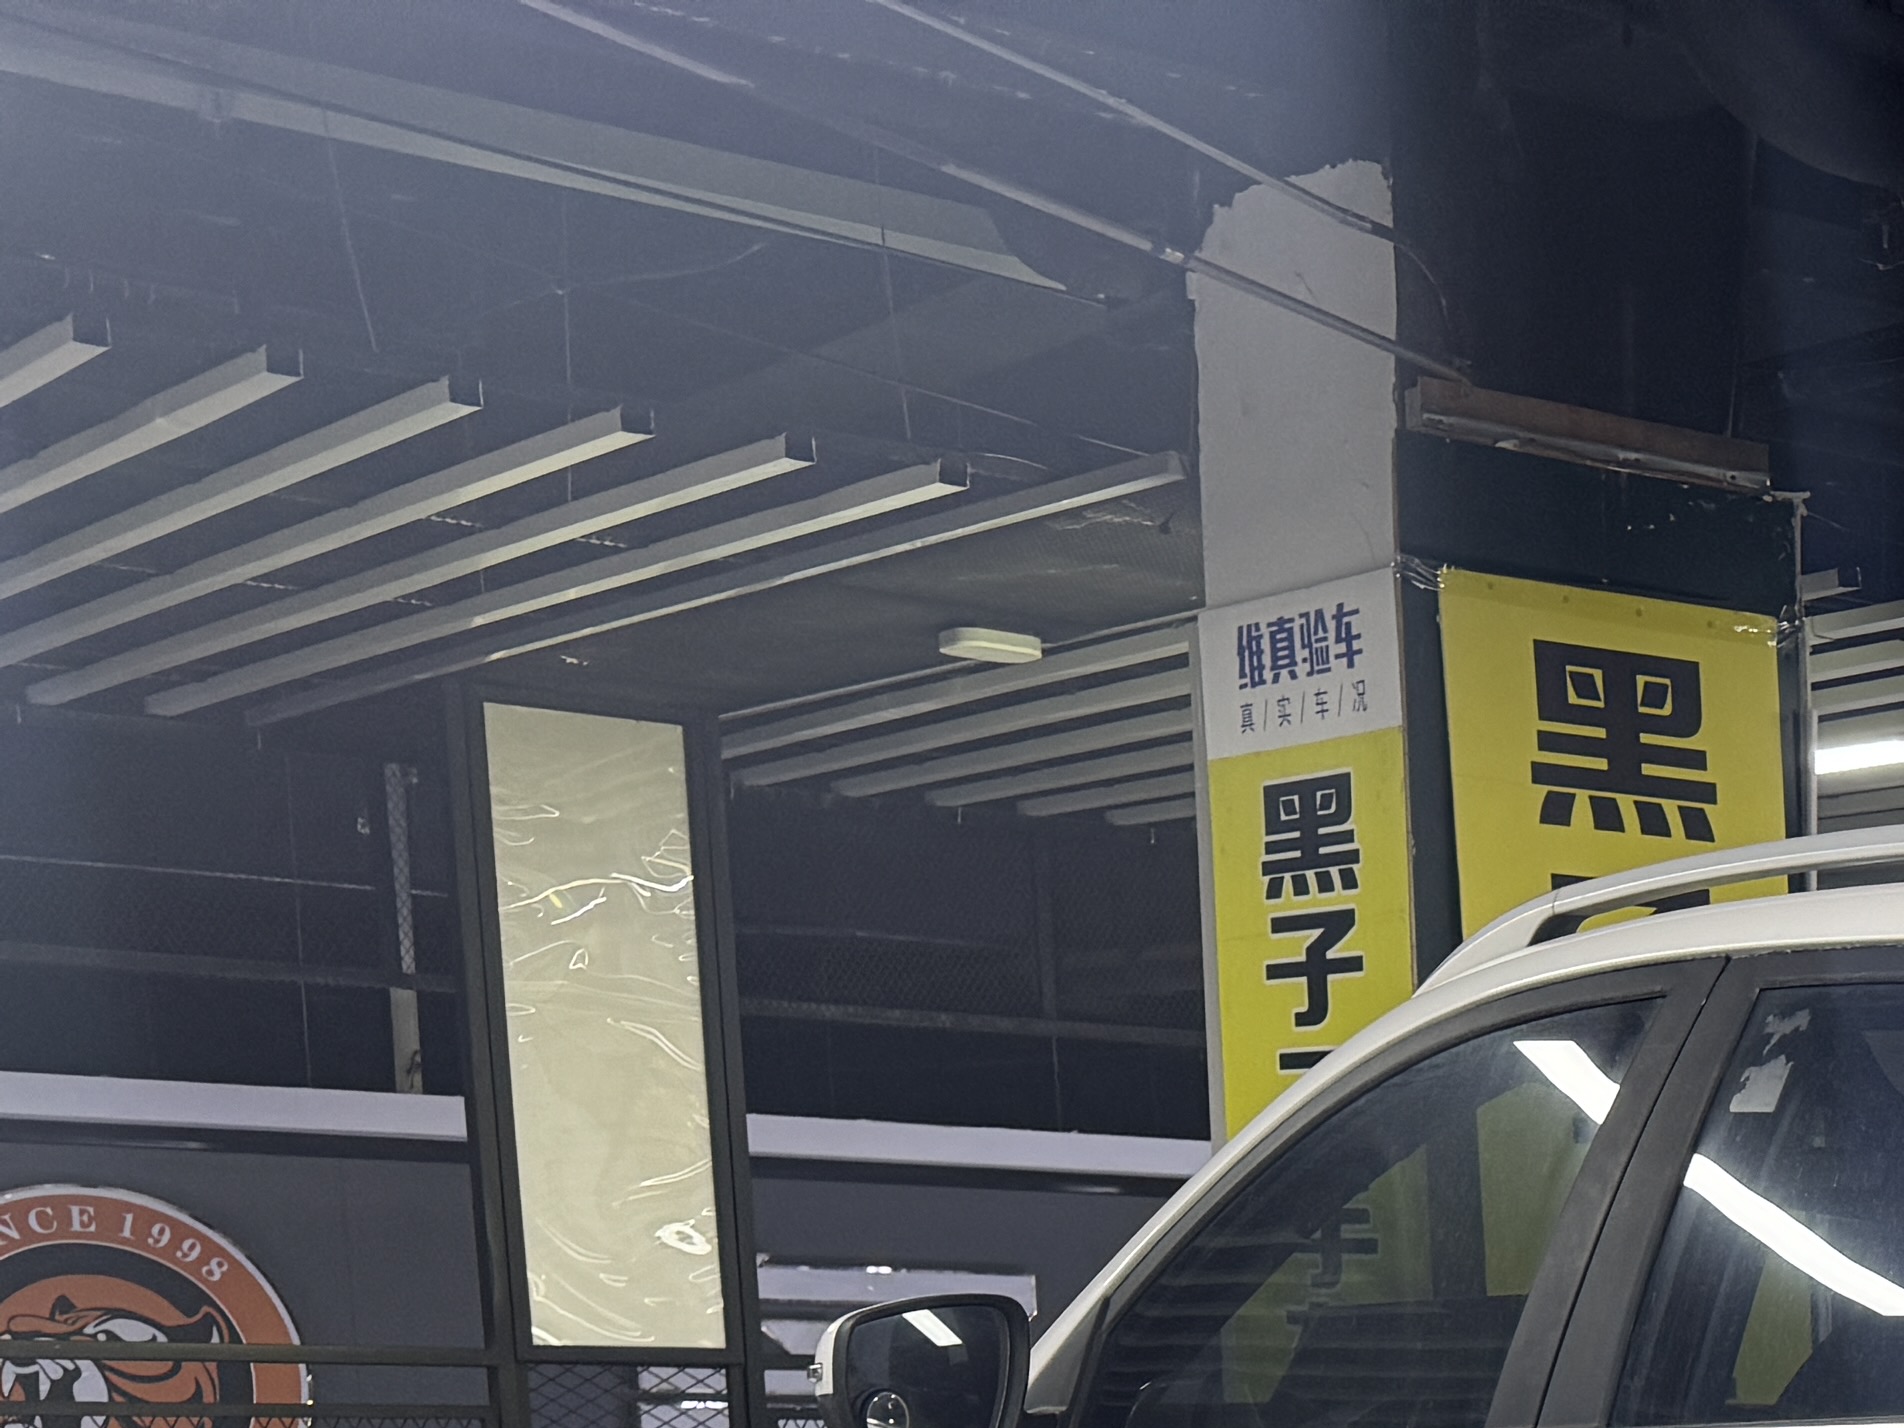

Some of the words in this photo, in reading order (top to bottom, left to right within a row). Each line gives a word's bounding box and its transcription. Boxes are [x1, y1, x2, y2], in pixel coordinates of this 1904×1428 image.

[1237, 602, 1363, 690] 维真验车
[119, 1212, 229, 1282] 1998
